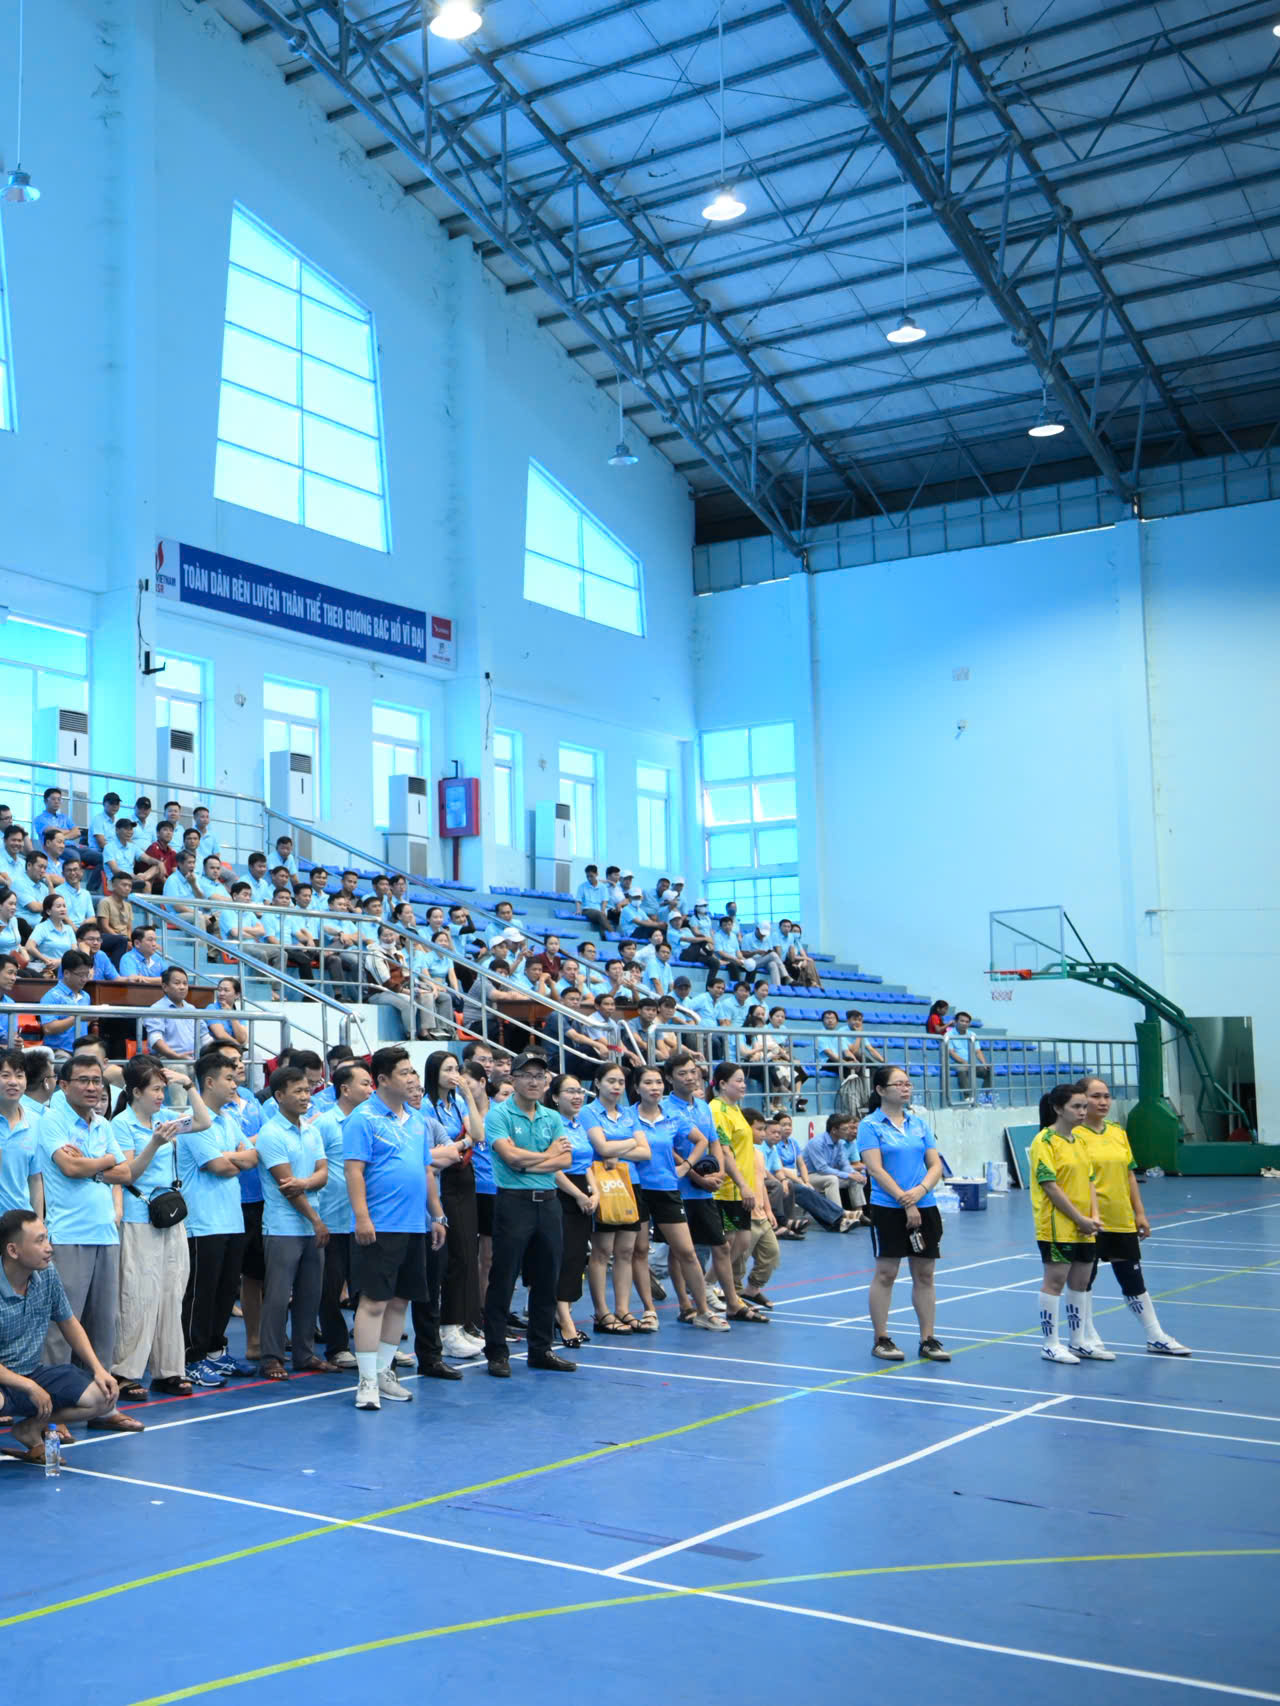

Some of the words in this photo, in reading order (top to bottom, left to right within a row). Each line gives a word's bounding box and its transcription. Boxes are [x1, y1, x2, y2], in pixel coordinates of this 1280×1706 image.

[183, 563, 208, 592] TOÀN
[210, 569, 230, 599] DÂN
[232, 574, 251, 604] RÈN
[252, 583, 280, 615] LUYỆN
[282, 590, 304, 618] THÂN
[323, 603, 343, 629] THEO
[373, 614, 389, 641] BÁC
